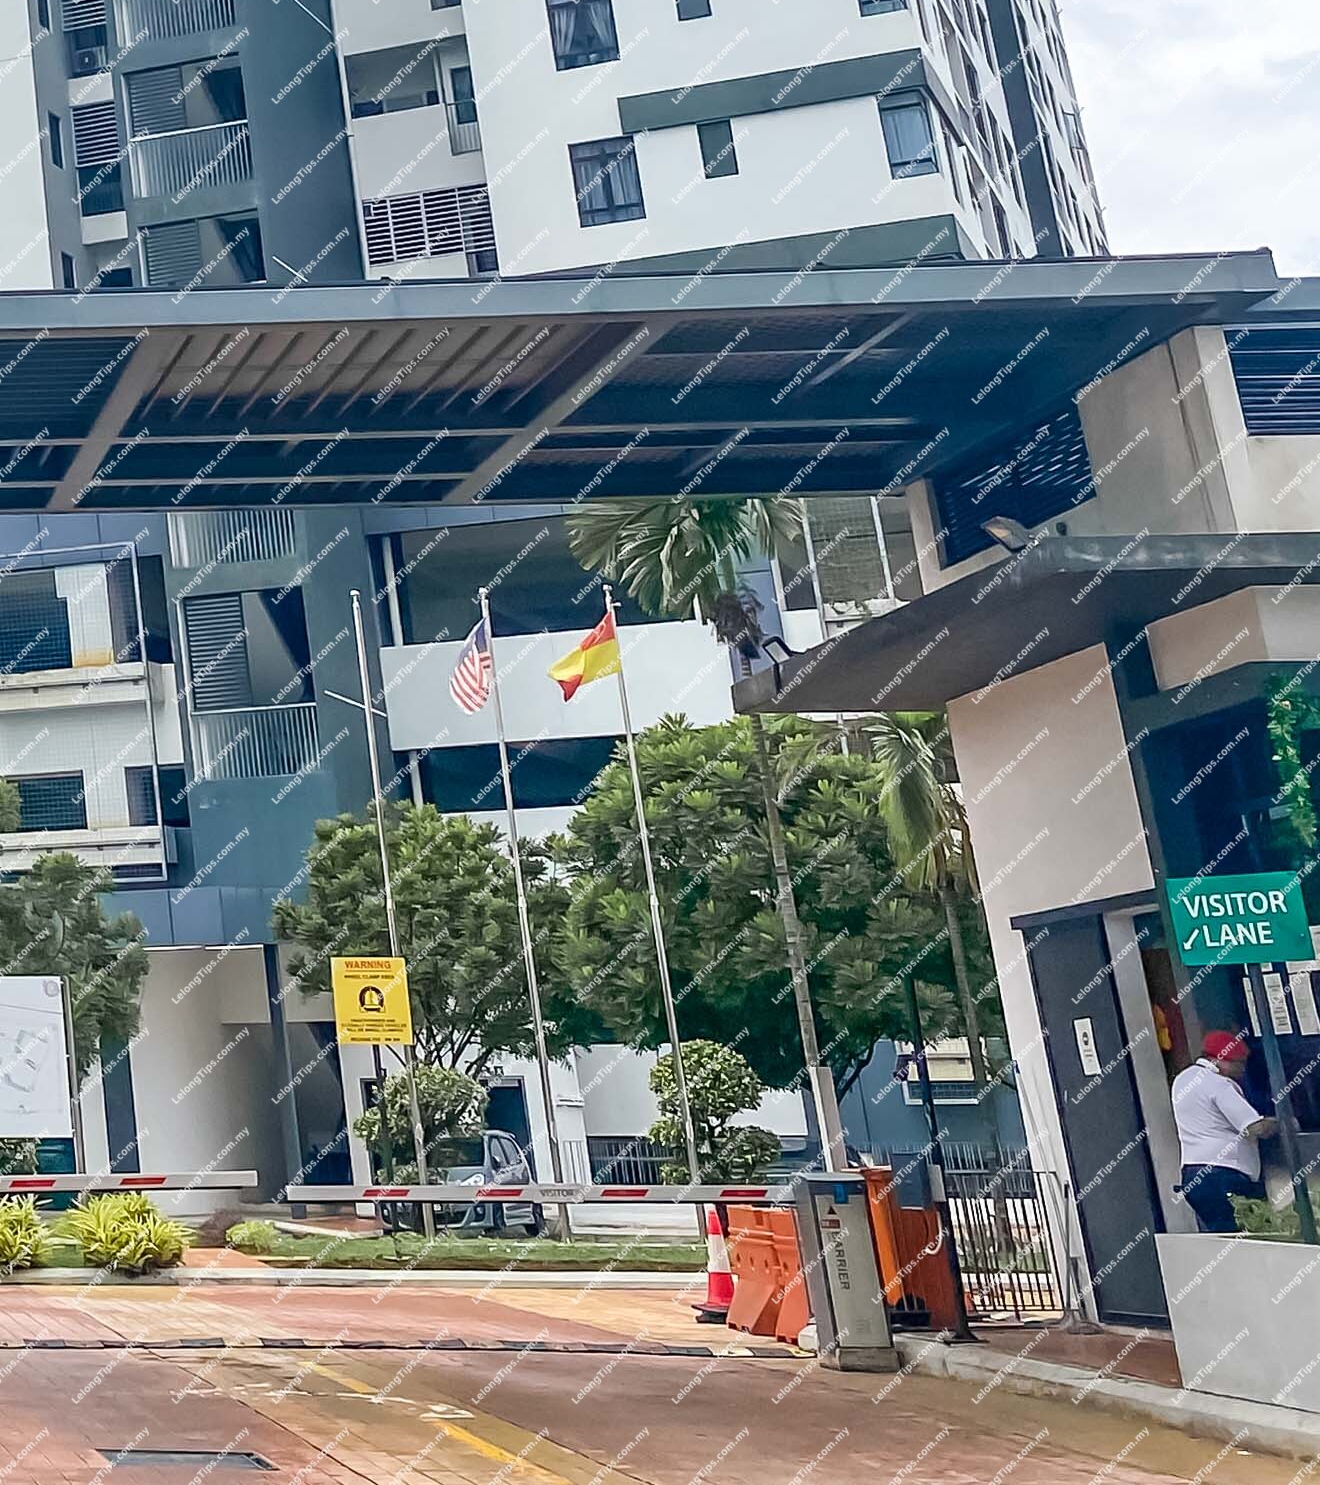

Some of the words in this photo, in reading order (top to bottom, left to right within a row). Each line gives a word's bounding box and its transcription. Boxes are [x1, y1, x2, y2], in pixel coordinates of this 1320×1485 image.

[1182, 890, 1287, 919] VISITOR
[1203, 921, 1274, 947] LANE
[344, 960, 392, 970] WARNING
